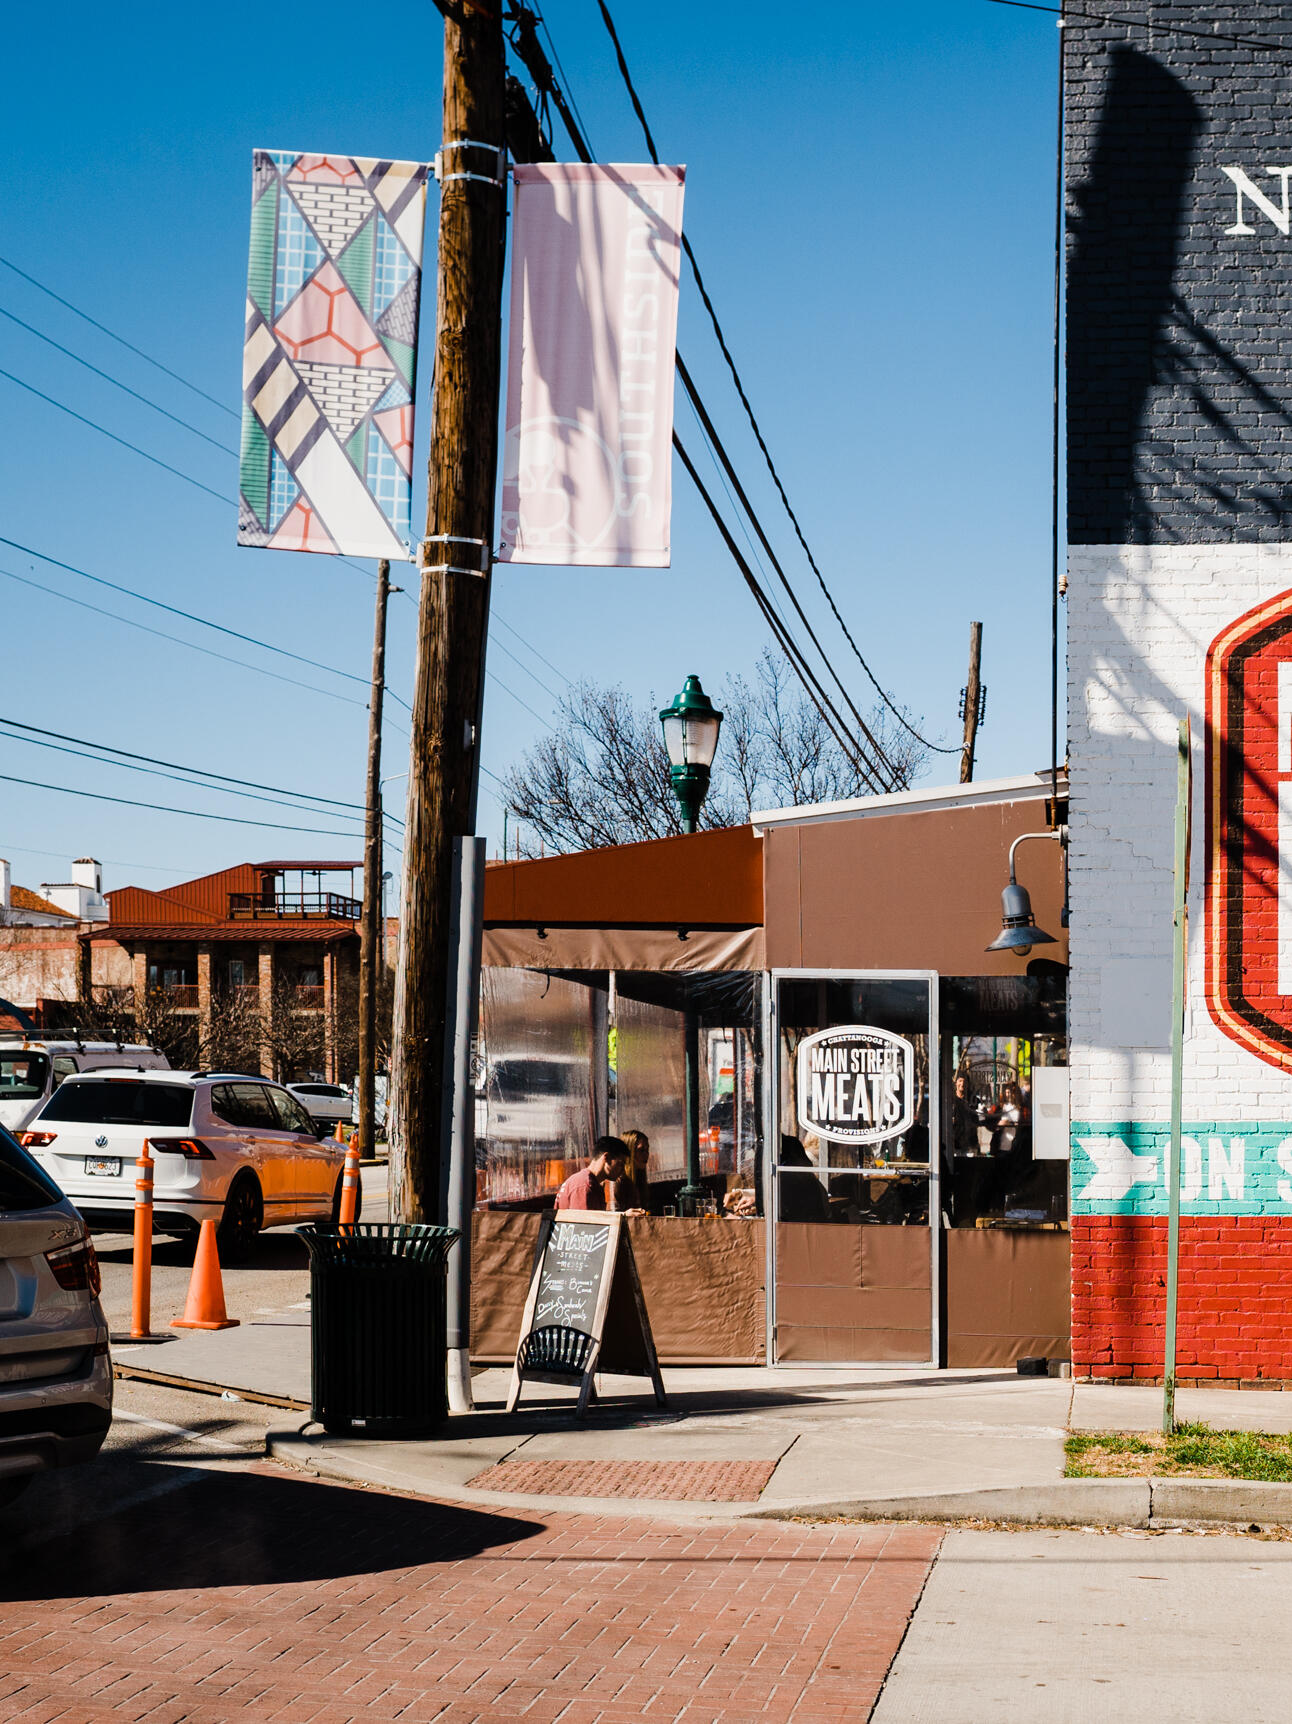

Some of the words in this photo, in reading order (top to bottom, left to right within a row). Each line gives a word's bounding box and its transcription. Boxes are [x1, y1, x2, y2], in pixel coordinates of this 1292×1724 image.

[617, 190, 664, 519] SOUTHSIDE
[827, 1034, 883, 1046] CHATTANOOGA
[811, 1047, 848, 1073] MAIN
[850, 1047, 900, 1073] STREET
[811, 1073, 900, 1122] MEATS
[832, 1125, 880, 1136] PROVISIONS
[1164, 1136, 1245, 1200] ON
